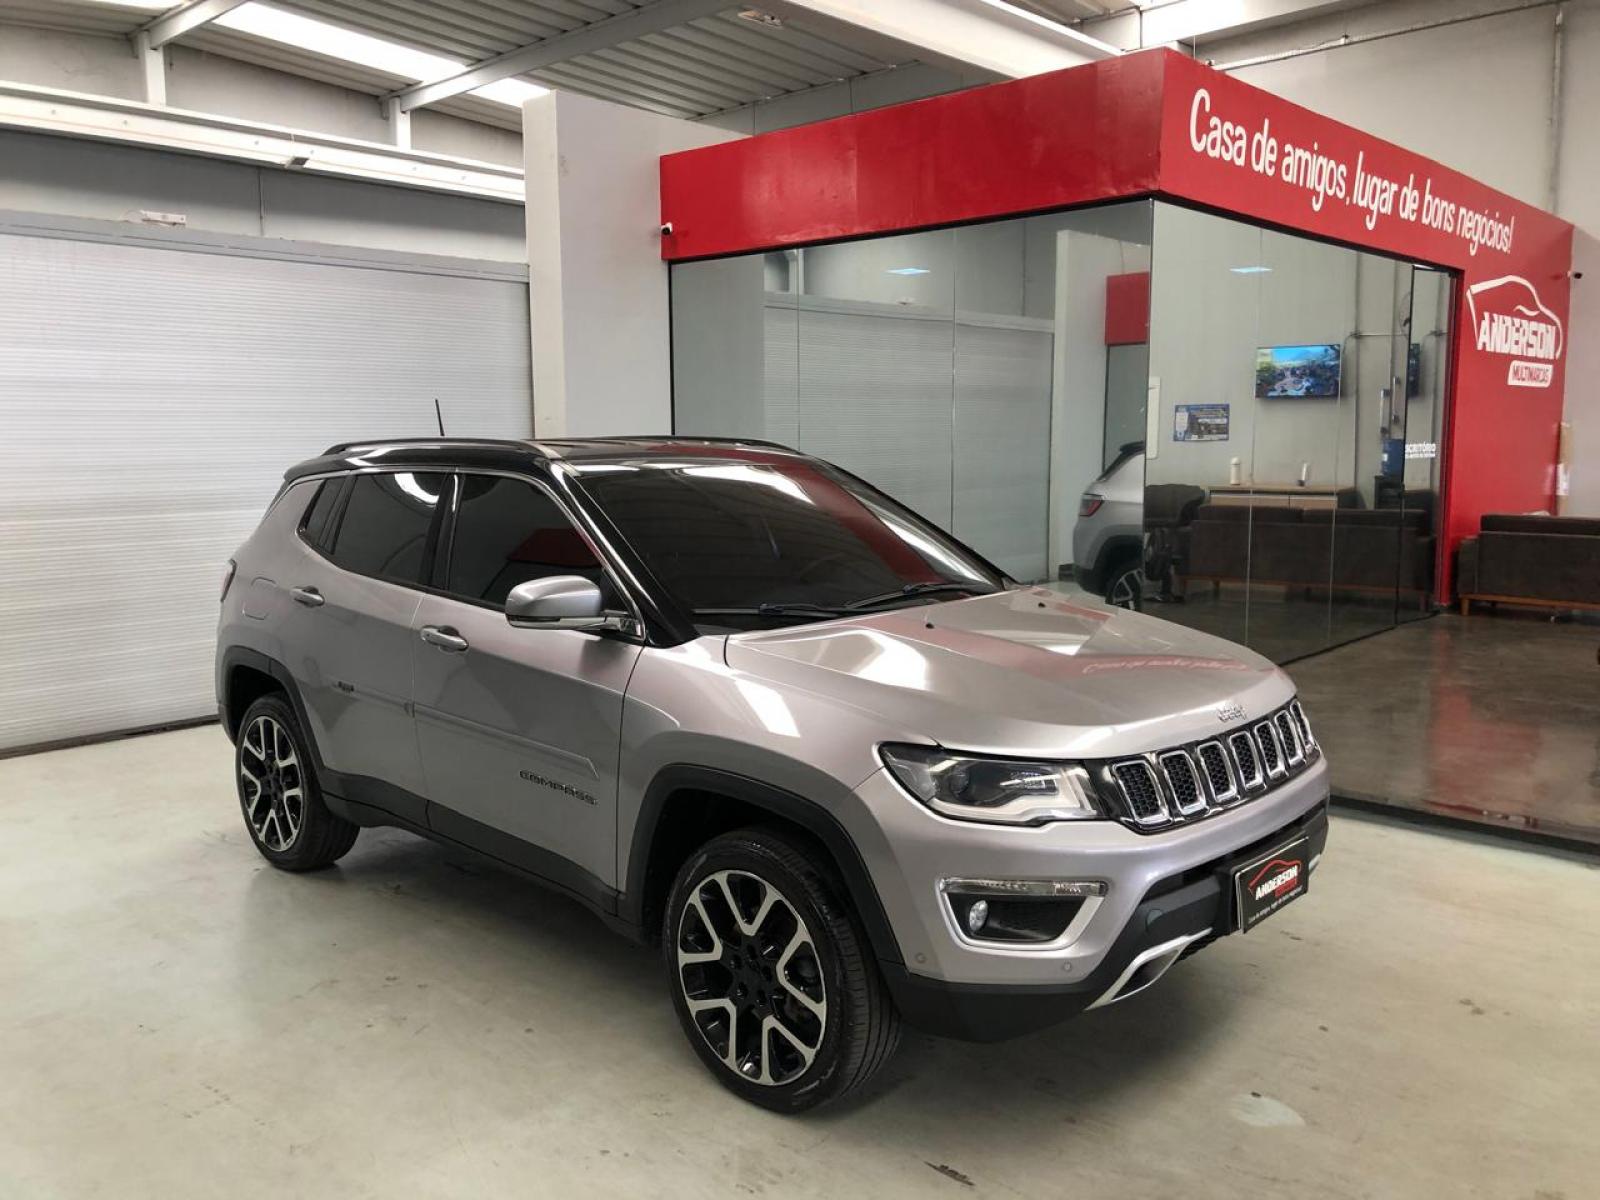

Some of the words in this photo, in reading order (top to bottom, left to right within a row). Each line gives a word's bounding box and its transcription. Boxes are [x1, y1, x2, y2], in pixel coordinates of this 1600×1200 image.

[1190, 88, 1247, 166] Casa
[1251, 118, 1277, 176] de
[1282, 142, 1350, 212] amigos,
[1353, 150, 1398, 230] lugar
[1400, 173, 1419, 222] de
[1421, 178, 1456, 233] bons
[1456, 209, 1515, 256] negócios!
[1477, 311, 1556, 360] ANDERSON
[519, 769, 597, 806] COMPASS
[1255, 864, 1298, 901] ANDERSON
